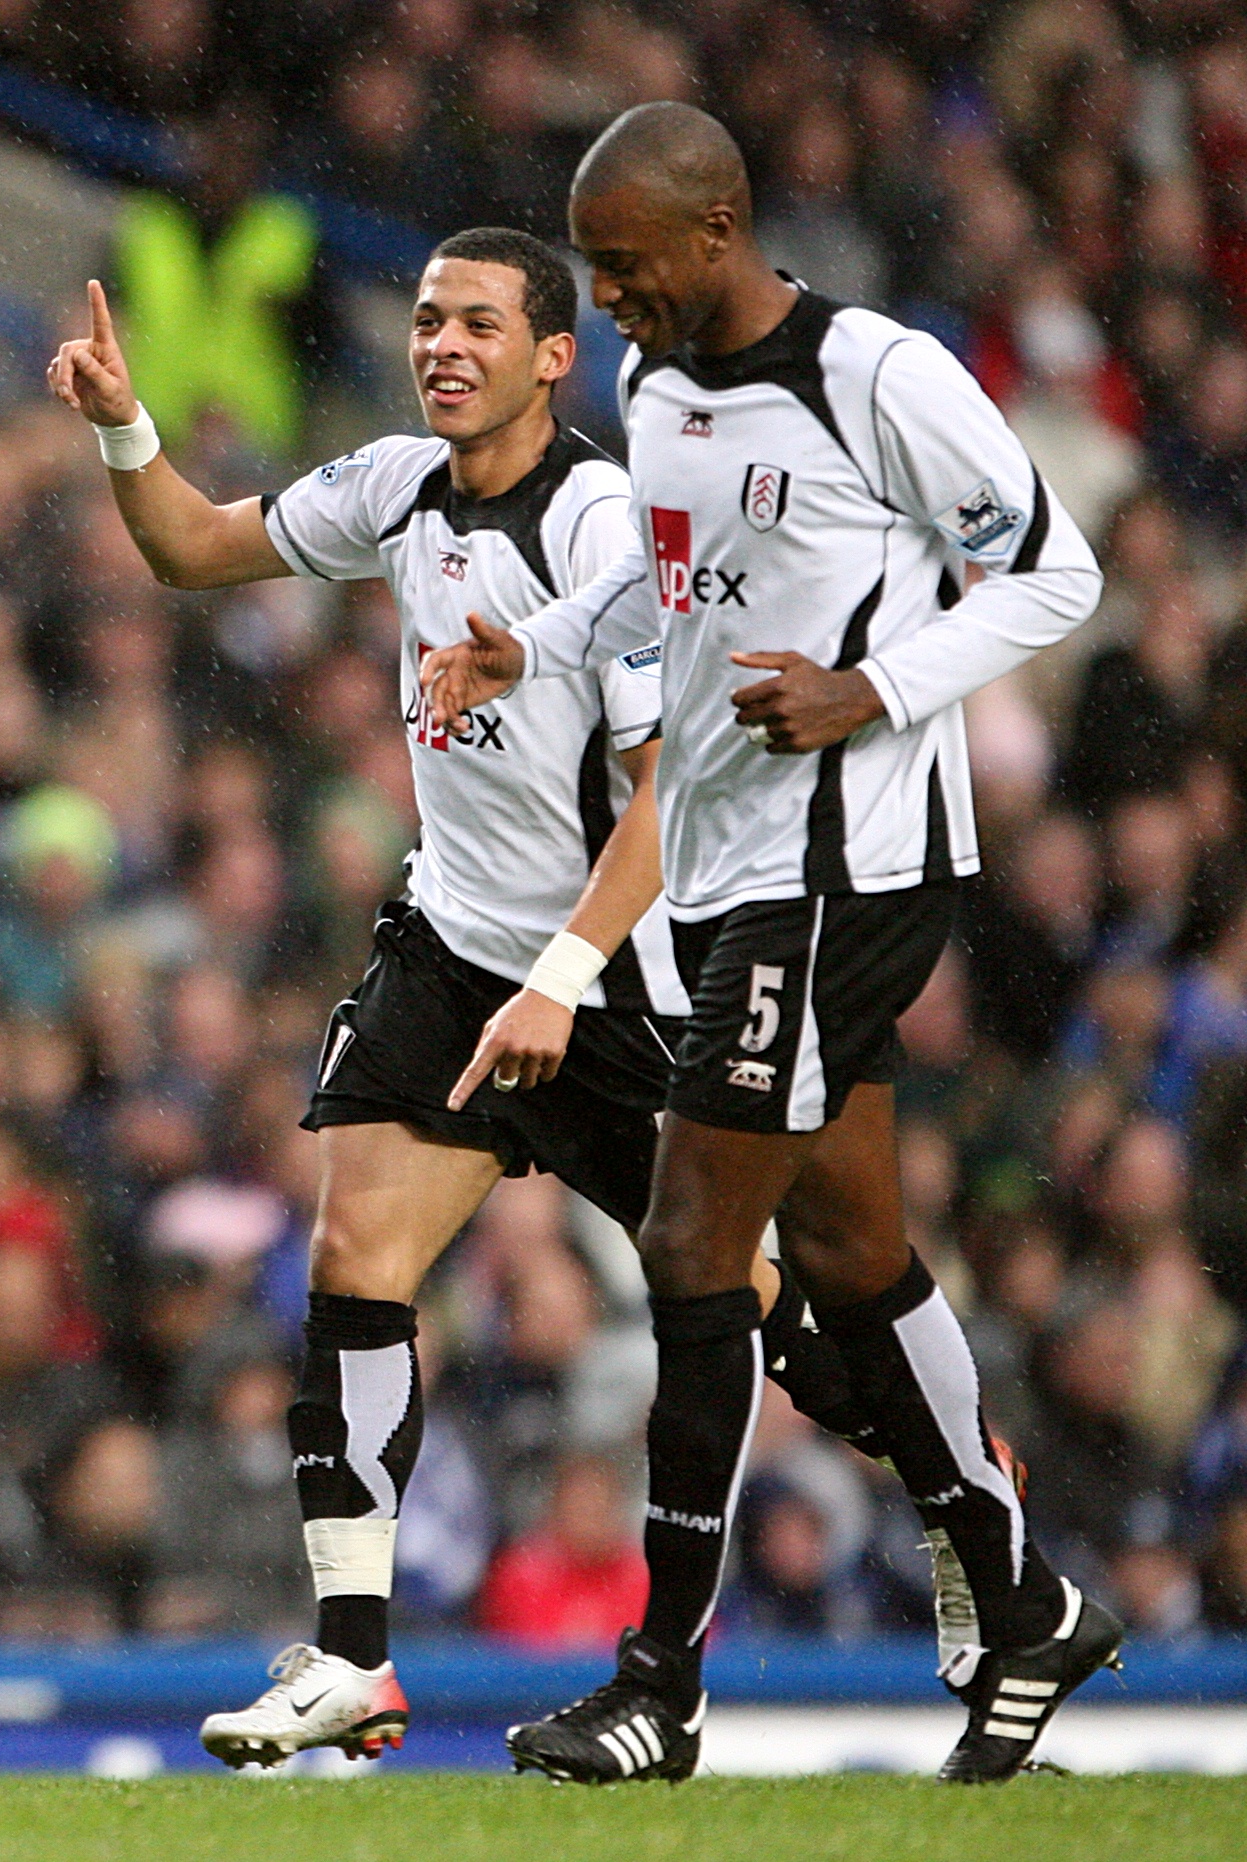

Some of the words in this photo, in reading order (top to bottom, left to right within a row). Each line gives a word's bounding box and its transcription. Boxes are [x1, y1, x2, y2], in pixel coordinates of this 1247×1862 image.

[655, 541, 748, 608] ipex
[631, 647, 663, 663] BARCL
[738, 963, 786, 1053] 5
